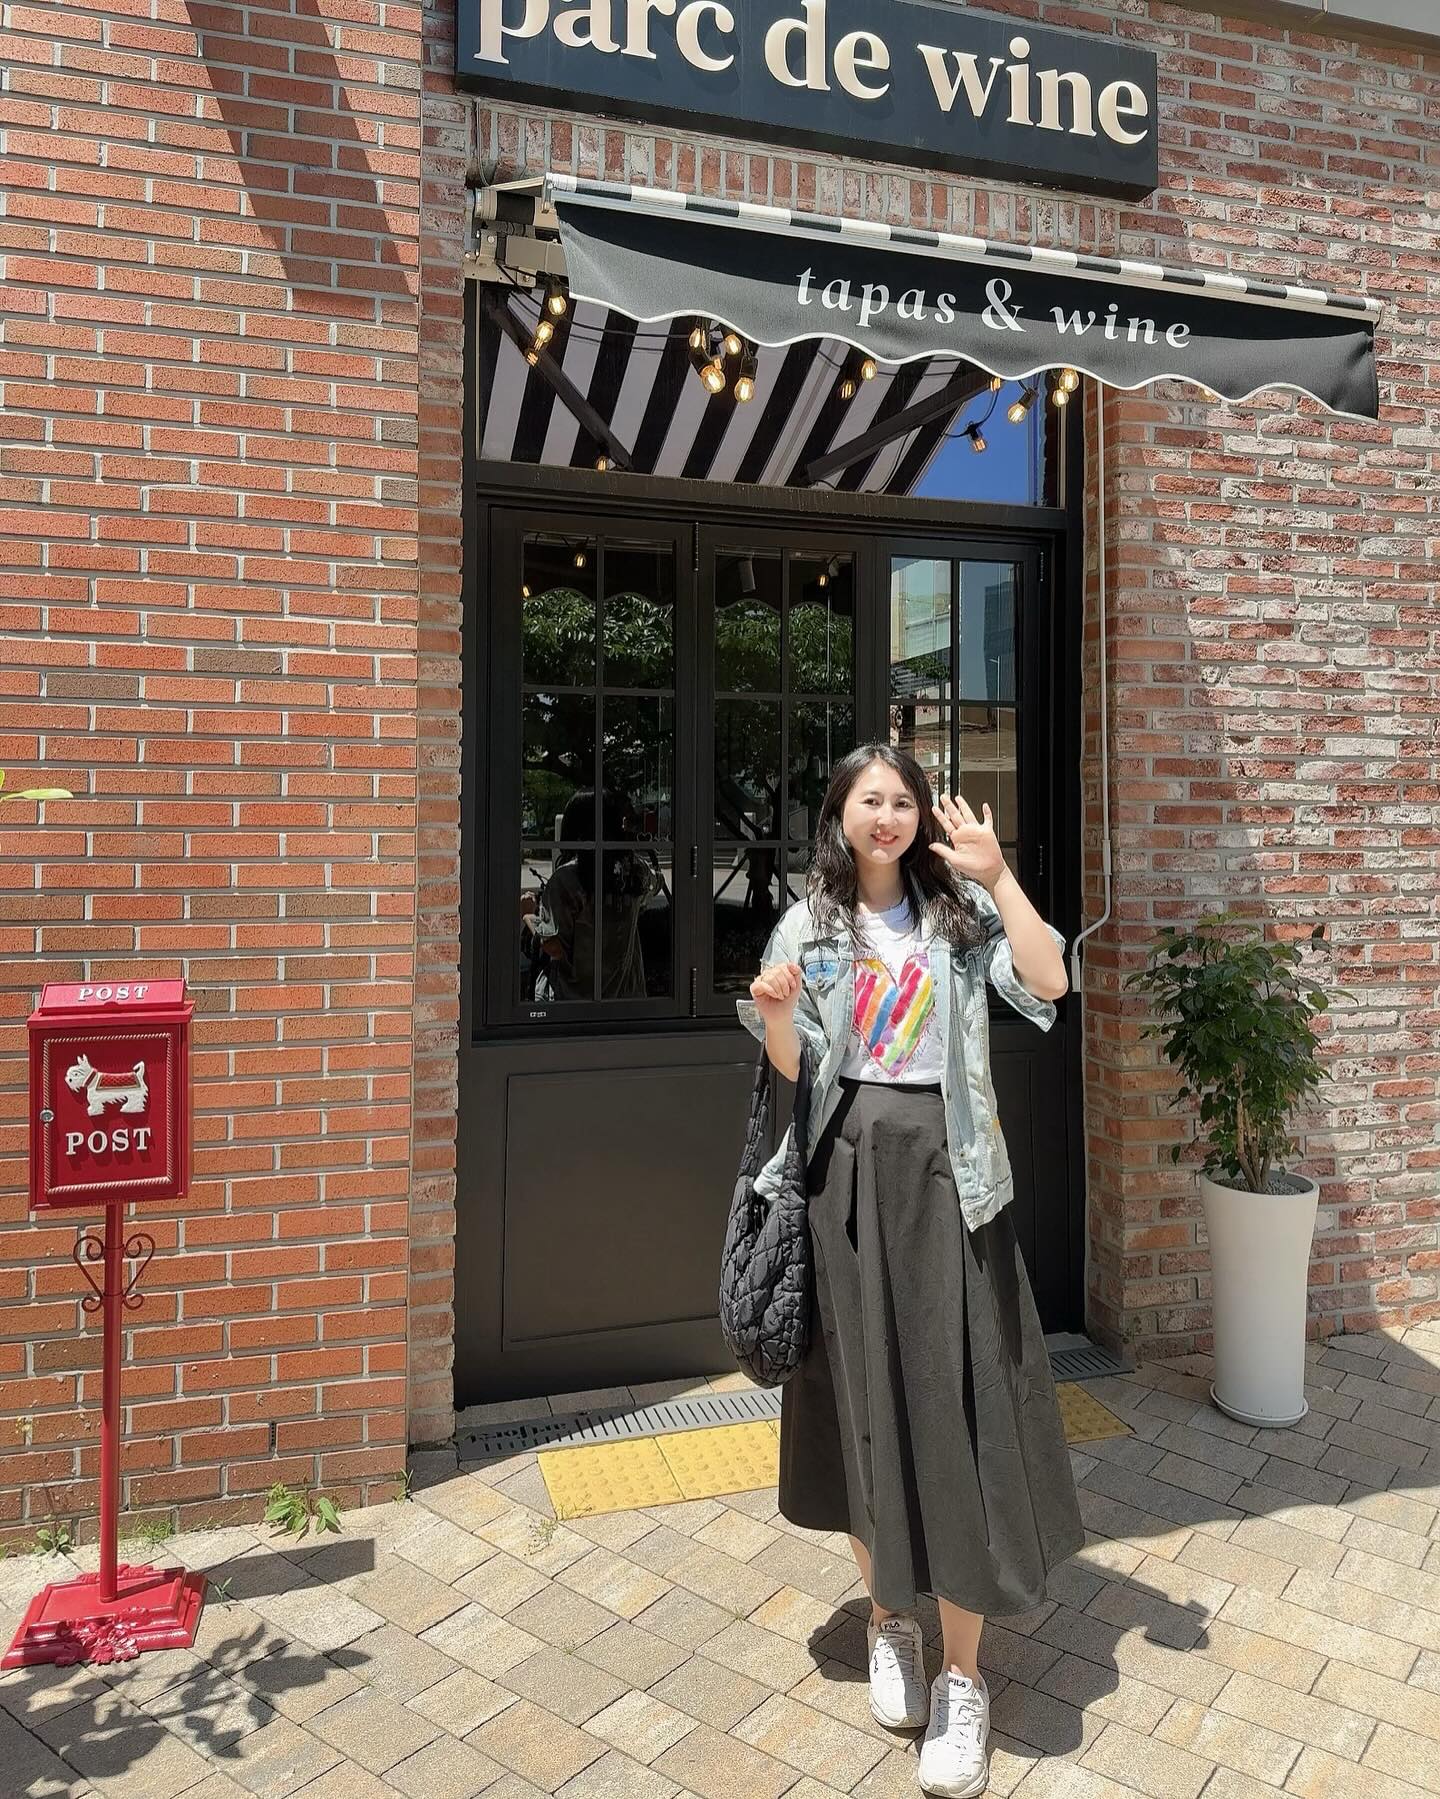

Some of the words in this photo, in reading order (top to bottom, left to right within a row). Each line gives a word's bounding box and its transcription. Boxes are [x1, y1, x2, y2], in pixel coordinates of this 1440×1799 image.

[473, 0, 735, 71] parc
[764, 0, 890, 99] de
[917, 37, 1149, 145] wine
[796, 267, 956, 327] tapas
[982, 278, 1027, 332] &
[1051, 303, 1190, 348] wine
[78, 984, 149, 1001] POST
[65, 1127, 151, 1155] POST
[884, 1621, 900, 1630] FILA
[948, 1678, 967, 1688] FILA
